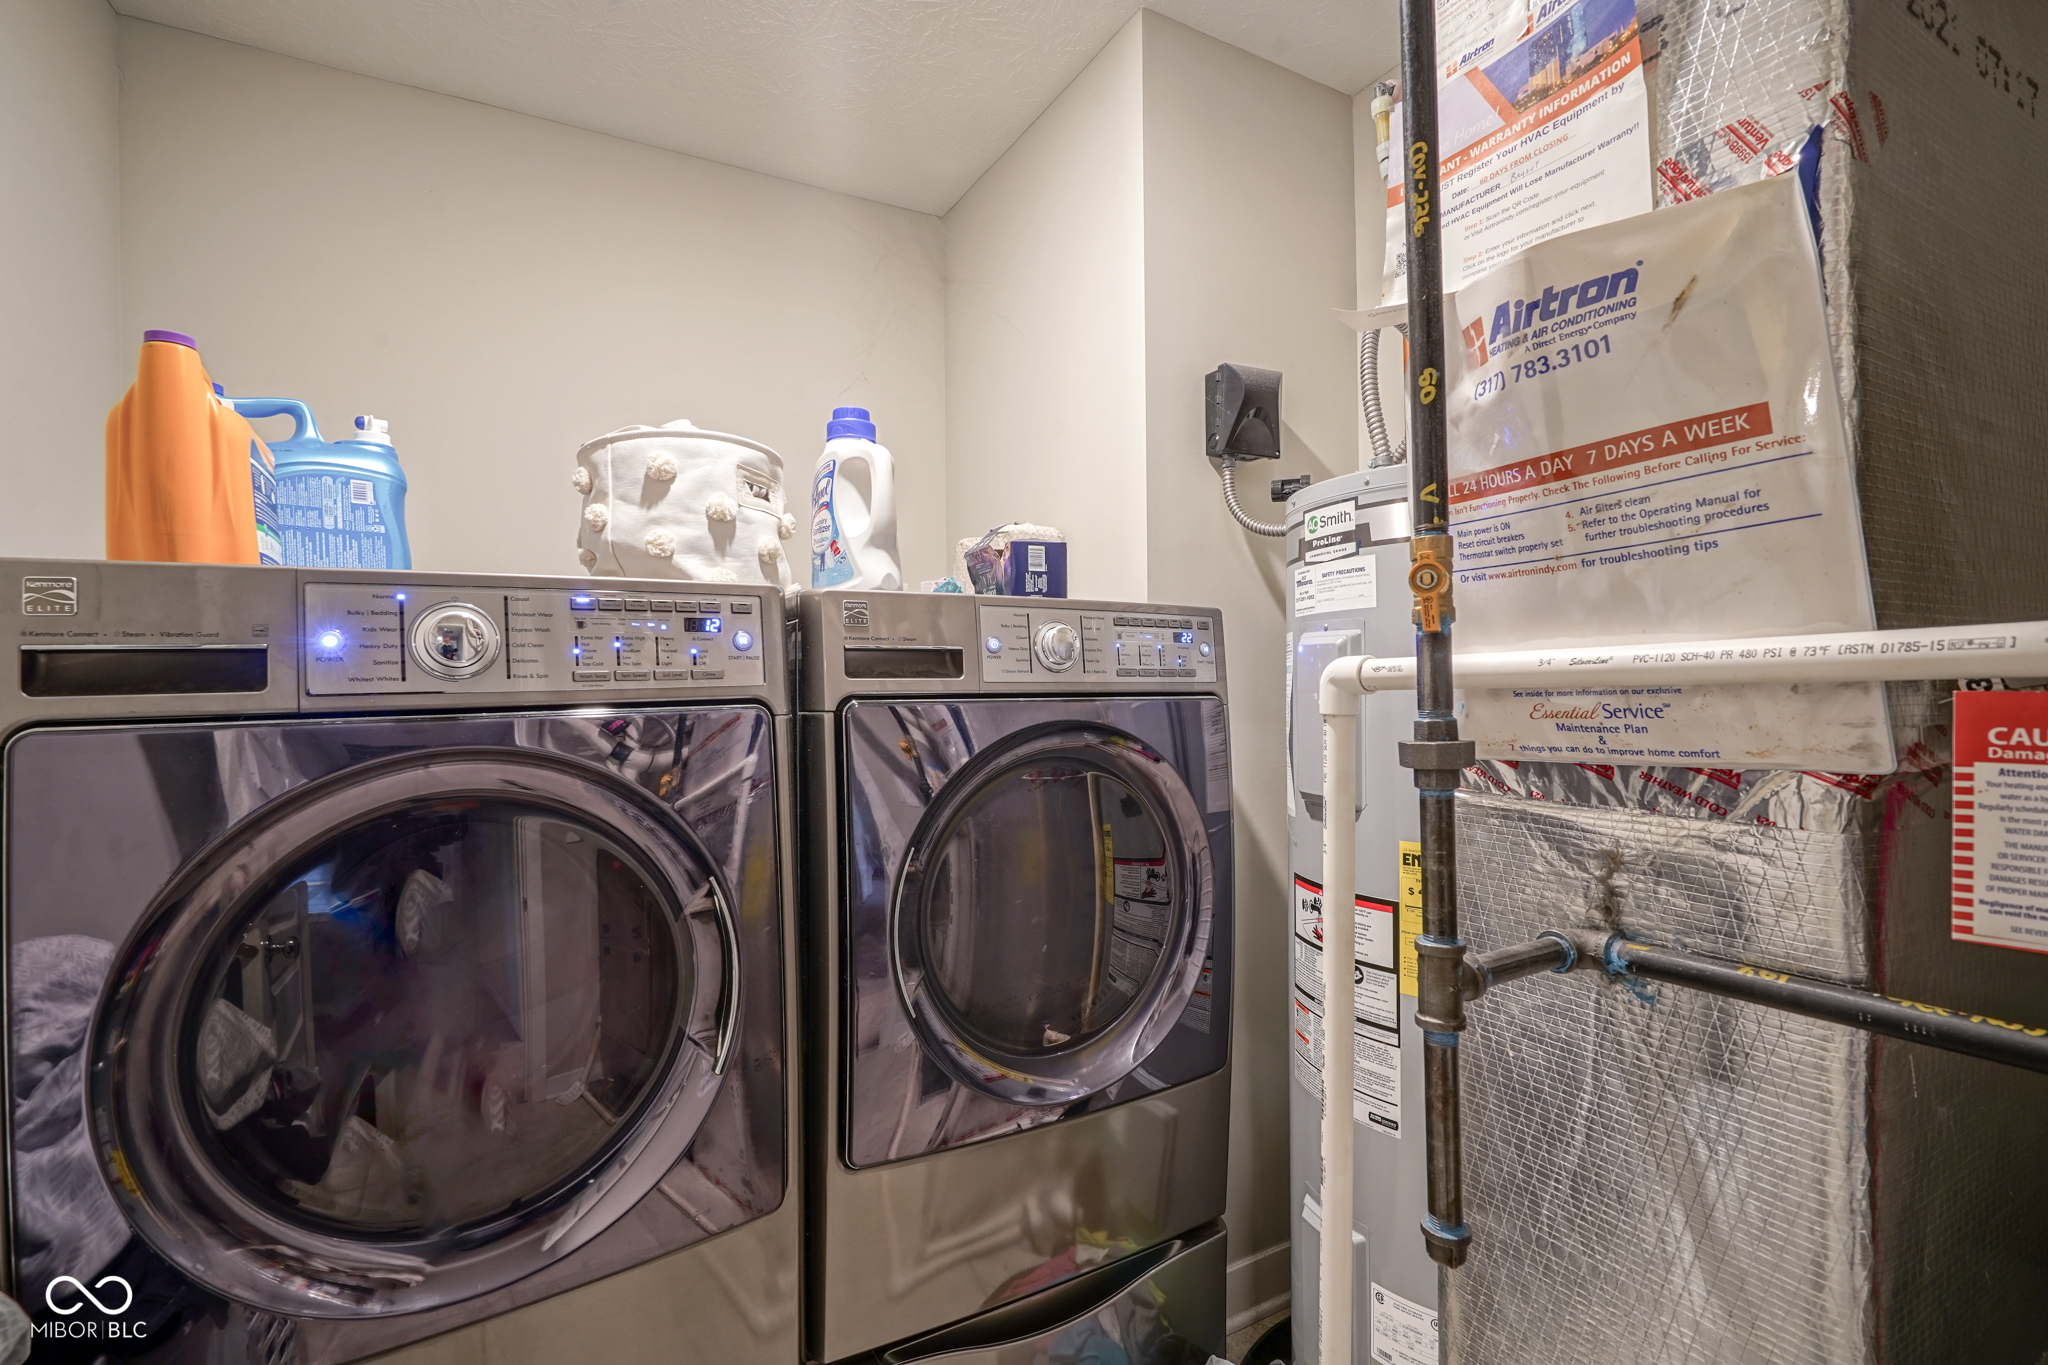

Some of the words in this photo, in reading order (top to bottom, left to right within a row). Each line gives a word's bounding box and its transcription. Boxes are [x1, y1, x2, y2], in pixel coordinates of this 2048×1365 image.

[1470, 114, 1536, 158] WARRANTY
[1539, 52, 1631, 119] INFORMATION
[1457, 158, 1493, 183] Register
[1496, 141, 1518, 159] Your
[1520, 126, 1550, 148] HVAC
[1552, 92, 1609, 130] Equipment
[1612, 82, 1625, 96] by
[1730, 140, 1751, 164] 1599B
[1451, 212, 1470, 225] HVAC
[1472, 192, 1508, 217] Equipment
[1510, 184, 1522, 198] Will
[1524, 174, 1542, 190] Lose
[1545, 148, 1596, 178] Manufacturer
[1598, 122, 1640, 151] Warranty!!
[1452, 186, 1470, 200] Date:
[1480, 175, 1488, 185] 60
[1490, 166, 1508, 182] DAYS
[1510, 152, 1532, 173] FROM
[1534, 134, 1569, 160] CLOSING
[1440, 183, 1502, 218] MANUFACTURER
[1489, 267, 1639, 345] Airtron
[1490, 336, 1520, 357] HEATING
[1532, 326, 1548, 340] AIR
[1551, 297, 1636, 333] CONDITIONING
[1533, 338, 1556, 351] Direct
[1594, 312, 1637, 329] Company
[1474, 371, 1505, 400] (317)
[1511, 334, 1610, 383] 783.3101
[1464, 480, 1476, 494] 24
[1481, 468, 1521, 490] HOURS
[1526, 465, 1536, 479] A
[1540, 454, 1574, 476] DAY
[1587, 450, 1596, 464] 7
[1604, 434, 1654, 460] DAYS
[1662, 430, 1677, 447] A
[1684, 412, 1750, 442] WEEK
[1454, 506, 1468, 516] Isn't
[1470, 498, 1506, 512] Functioning
[1508, 492, 1540, 505] Properly.
[1542, 484, 1570, 497] Check
[1572, 480, 1590, 490] The
[1592, 469, 1640, 486] Following
[1644, 460, 1681, 475] Before
[1684, 451, 1728, 466] Calling
[1732, 446, 1752, 456] For
[1756, 435, 1806, 451] Service:
[1580, 506, 1592, 516] Air
[1595, 500, 1622, 514] filters
[1625, 496, 1650, 507] clean
[1582, 518, 1605, 529] Refer
[1609, 516, 1618, 524] to
[1621, 512, 1636, 522] the
[1640, 502, 1692, 521] Operating
[1696, 491, 1739, 508] Manual
[1744, 488, 1761, 499] for
[1458, 529, 1472, 538] Main
[1474, 528, 1492, 538] power
[1500, 522, 1510, 530] ON
[1585, 530, 1616, 542] further
[1619, 515, 1700, 536] troubleshooting
[1704, 503, 1770, 523] procedures
[1458, 540, 1474, 550] Reset
[1476, 536, 1495, 547] circuit
[1498, 532, 1524, 544] breakers
[1459, 550, 1493, 561] Thermostat
[1494, 546, 1516, 556] switch
[1518, 540, 1548, 555] properly
[1551, 539, 1563, 547] set
[1460, 574, 1470, 583] Or
[1472, 572, 1486, 582] visit
[1488, 562, 1578, 580] www.airtronindy.com
[1581, 559, 1596, 568] for
[1600, 544, 1690, 565] troubleshooting
[1694, 539, 1719, 552] tips
[26, 580, 72, 588] Kenmore
[705, 618, 720, 632] 12
[1182, 632, 1192, 643] 22
[1632, 653, 1676, 664] PVC-1120
[1680, 651, 1714, 662] SCH-40
[1720, 650, 1733, 660] PR
[1739, 648, 1757, 659] 480
[1763, 647, 1782, 658] PSI
[1790, 647, 1796, 657] @
[1838, 644, 1874, 655] [ASTM
[1881, 640, 1946, 654] D1785-15
[1576, 688, 1618, 696] Information
[1530, 702, 1602, 720] Essential
[1556, 723, 1620, 734] Maintenance
[1624, 724, 1648, 734] Plan
[1599, 736, 1607, 745] &
[1988, 727, 2048, 746] CAU
[1520, 744, 1546, 753] things
[1608, 748, 1644, 757] improve
[1648, 748, 1675, 757] home
[1678, 750, 1720, 759] comfort
[1638, 770, 1692, 800] WEATHER
[1694, 795, 1728, 818] COLD
